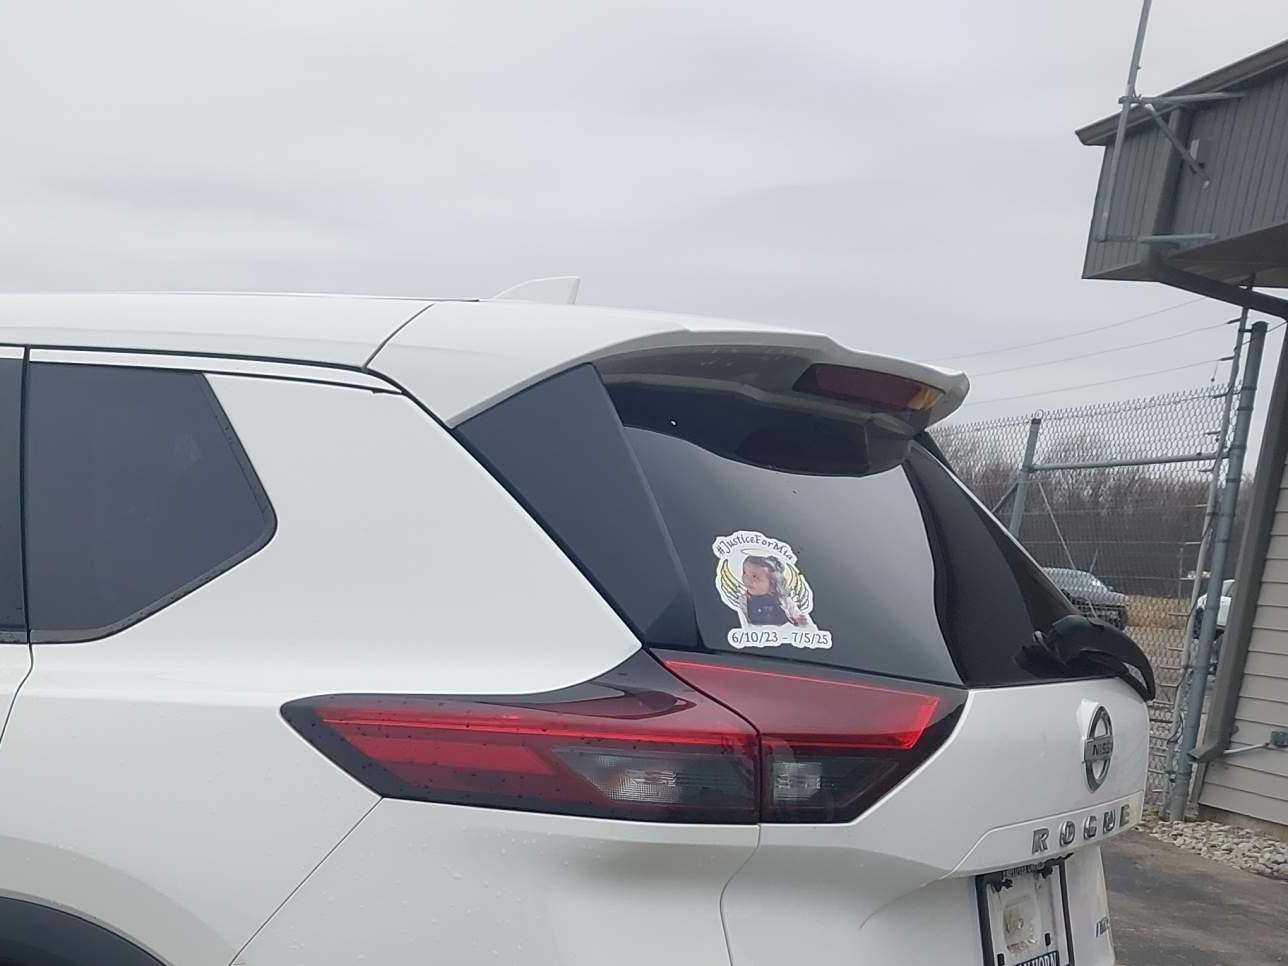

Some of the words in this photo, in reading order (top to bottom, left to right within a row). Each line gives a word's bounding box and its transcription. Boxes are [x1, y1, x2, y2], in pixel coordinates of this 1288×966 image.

[715, 533, 794, 561] #JusticeForMia
[731, 630, 778, 644] 6/10/23
[791, 631, 829, 645] 7/5/25
[1031, 803, 1130, 855] ROGUE
